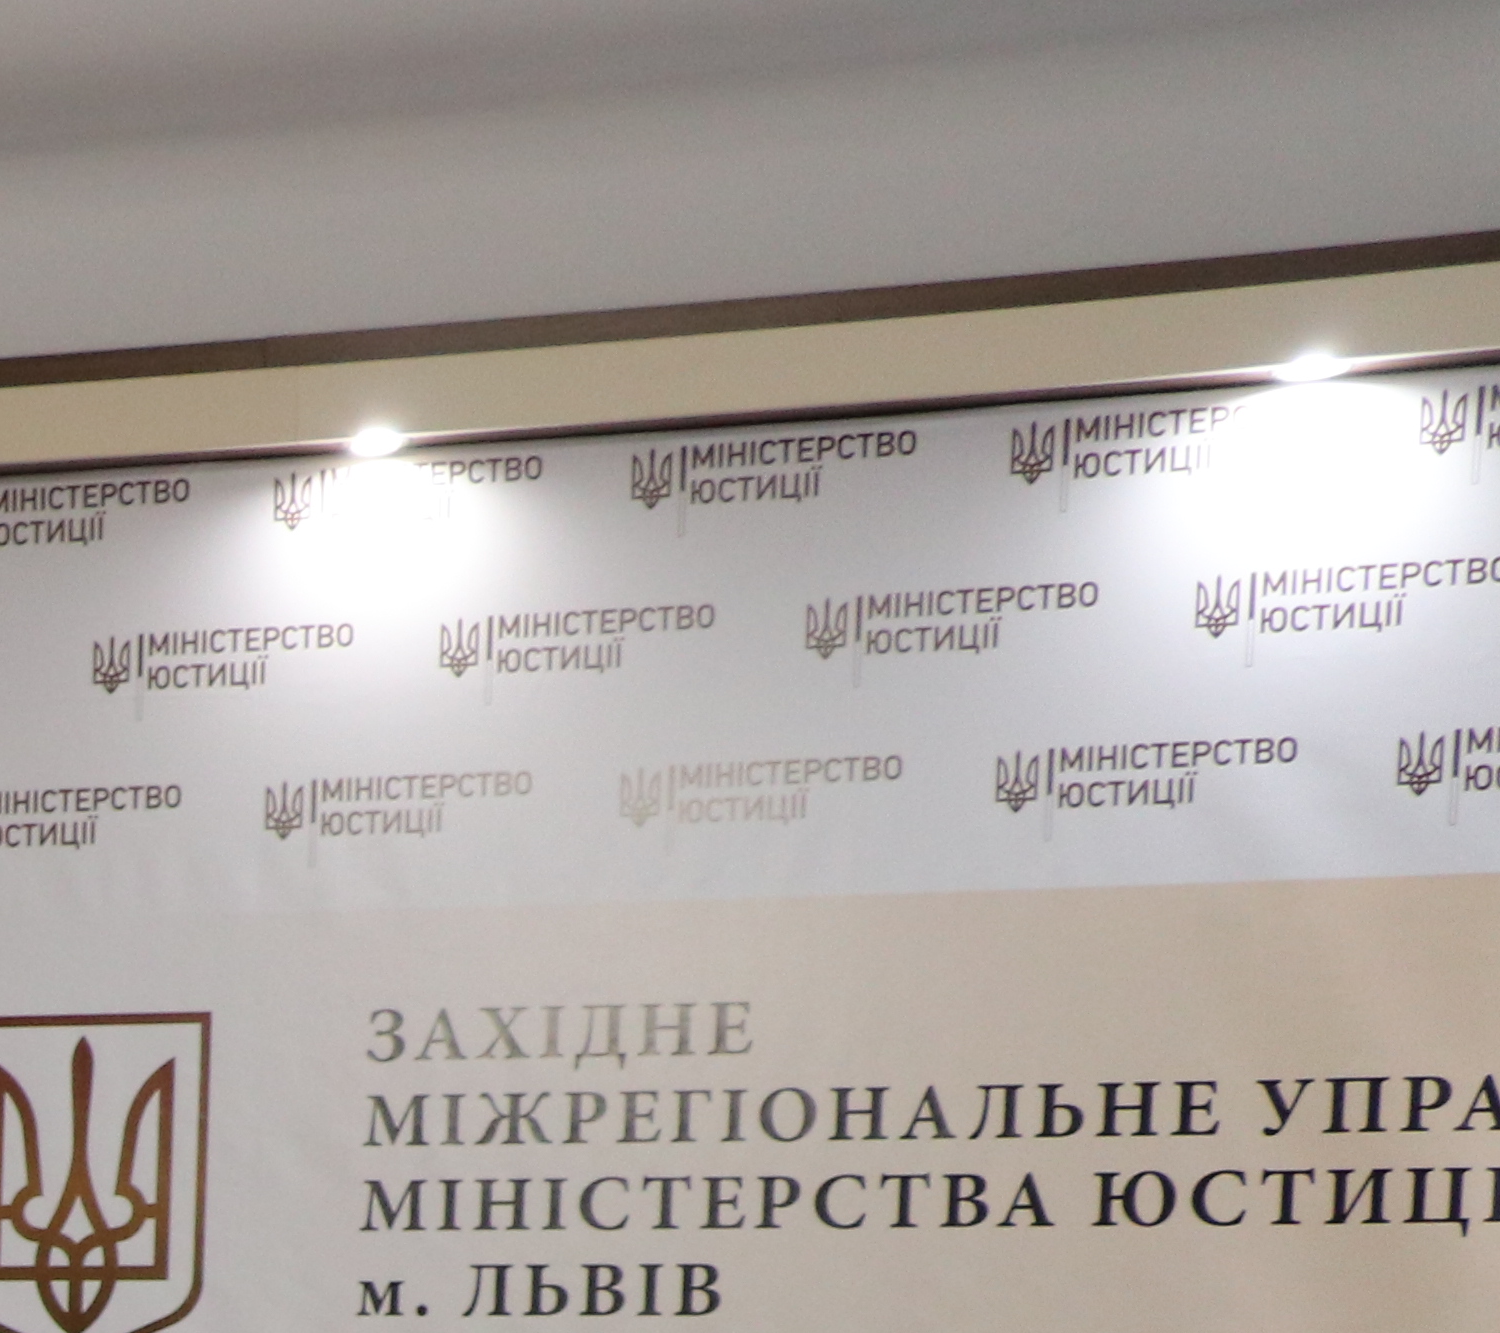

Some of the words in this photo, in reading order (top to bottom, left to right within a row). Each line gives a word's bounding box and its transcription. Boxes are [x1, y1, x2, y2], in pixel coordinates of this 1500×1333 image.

[1076, 405, 1248, 443] МІНІСТЕР
[692, 430, 918, 469] МІНІСТЕРСТВО
[690, 467, 822, 504] ЮСТИЦІЇ
[867, 580, 1100, 620] МІНІСТЕРСТВО
[1259, 592, 1406, 634] ЮСТИЦІЇ
[148, 622, 355, 657] МІНІСТЕРСТВО
[497, 603, 716, 641] МІНІСТЕРСТВО
[865, 616, 1002, 656] ЮСТИЦІЇ
[147, 654, 268, 691] ЮСТИЦІЇ
[496, 636, 624, 675] ЮСТИЦІЇ
[678, 754, 903, 792] МІНІСТЕРСТВО
[1058, 736, 1299, 774] МІНІСТЕРСТВО
[320, 769, 533, 803] МІНІСТЕРСТВО
[1057, 772, 1198, 809] ЮСТИЦІЇ
[319, 803, 444, 838] ЮСТИЦІЇ
[677, 788, 810, 824] ЮСТИЦІЇ
[366, 1000, 756, 1069] ЗАХІДНЕ
[363, 1078, 1221, 1149] МІЖРЕГІОНАЛЬНЕ
[359, 1166, 1057, 1233] МІНІСТЕРСТВА
[357, 1278, 429, 1319] м.
[461, 1260, 724, 1319] ЛЬВІВ
